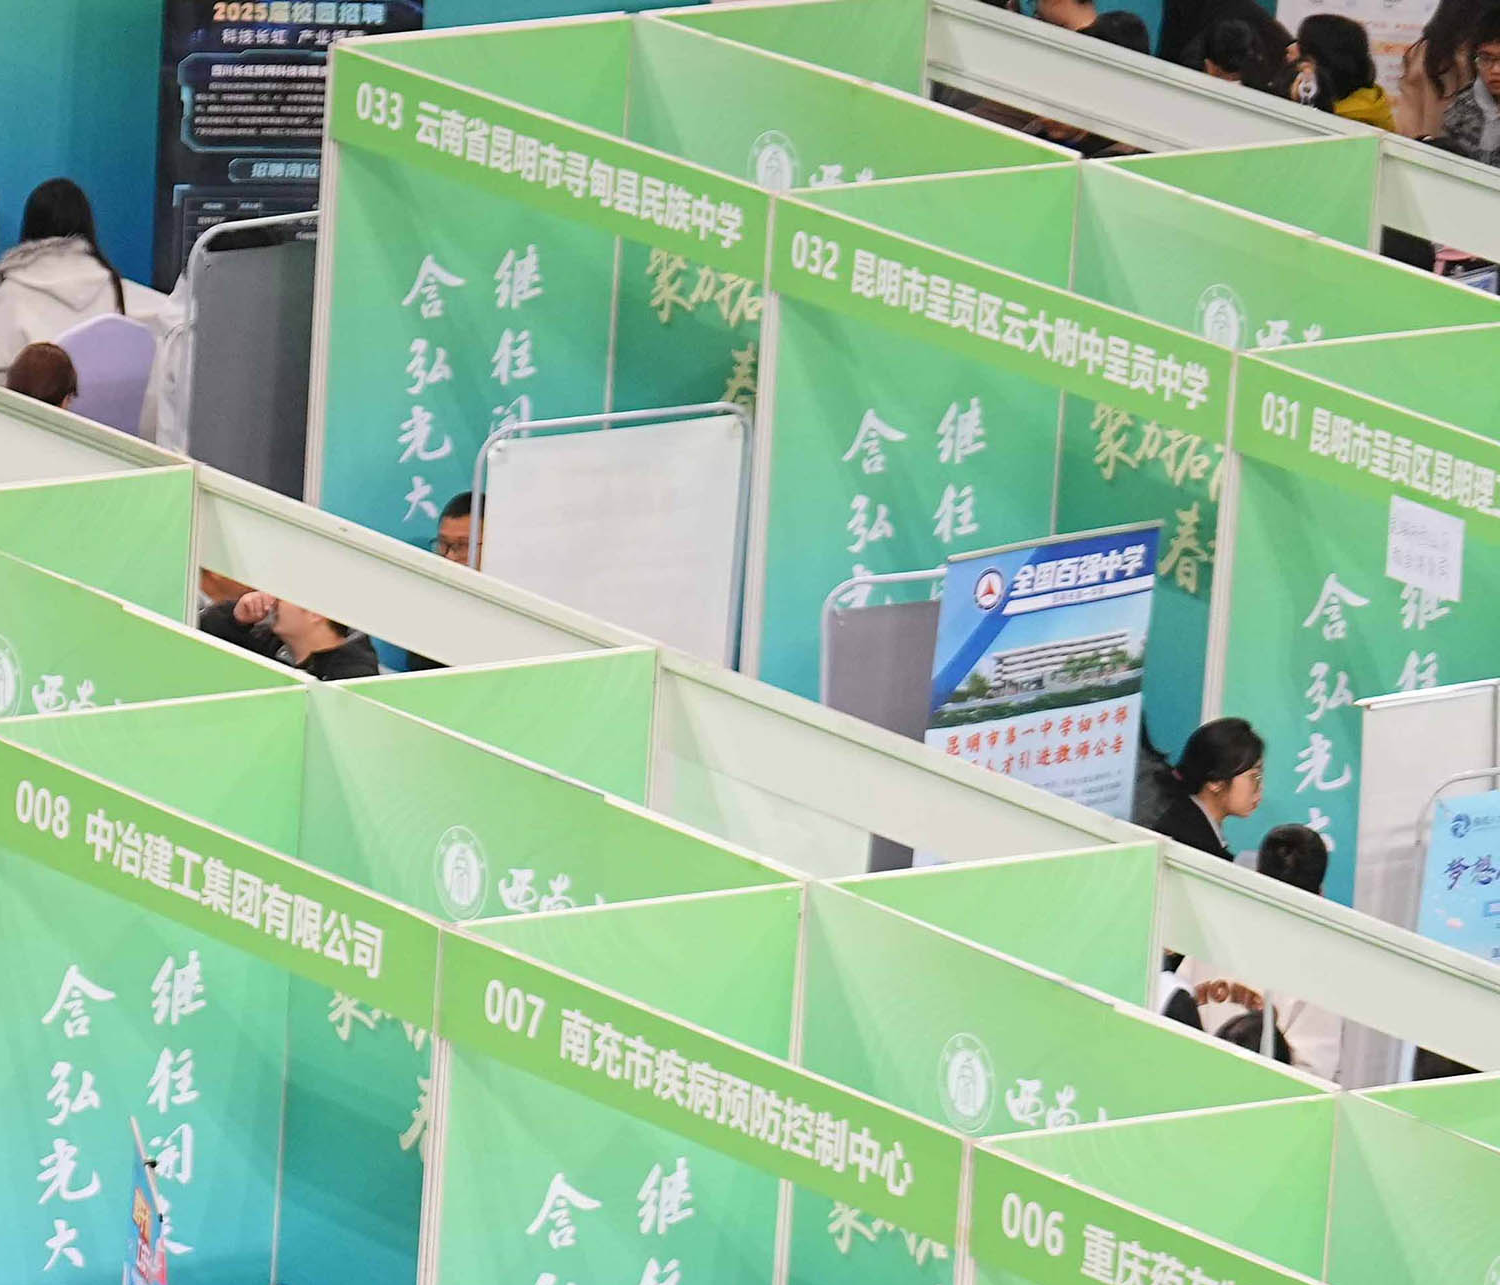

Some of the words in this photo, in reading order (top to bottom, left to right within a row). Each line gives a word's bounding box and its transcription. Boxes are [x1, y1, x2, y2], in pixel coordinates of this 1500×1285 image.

[357, 83, 403, 130] 033
[415, 98, 743, 247] 云南省昆明市寻甸县民族中学
[396, 256, 466, 523] 含弘光大
[792, 230, 838, 280] 032
[850, 249, 1209, 408] 昆明市呈贡区云大附中呈贡中学
[1261, 392, 1300, 440] 031
[1011, 544, 1146, 597] 全国百强中学
[15, 781, 70, 840] 008
[85, 806, 384, 978] 中冶建工集团有限公司
[33, 965, 117, 1272] 含弘光大
[485, 980, 544, 1040] 007
[560, 1010, 914, 1197] 南充市疾病预防控制中心
[1002, 1193, 1063, 1257] 006
